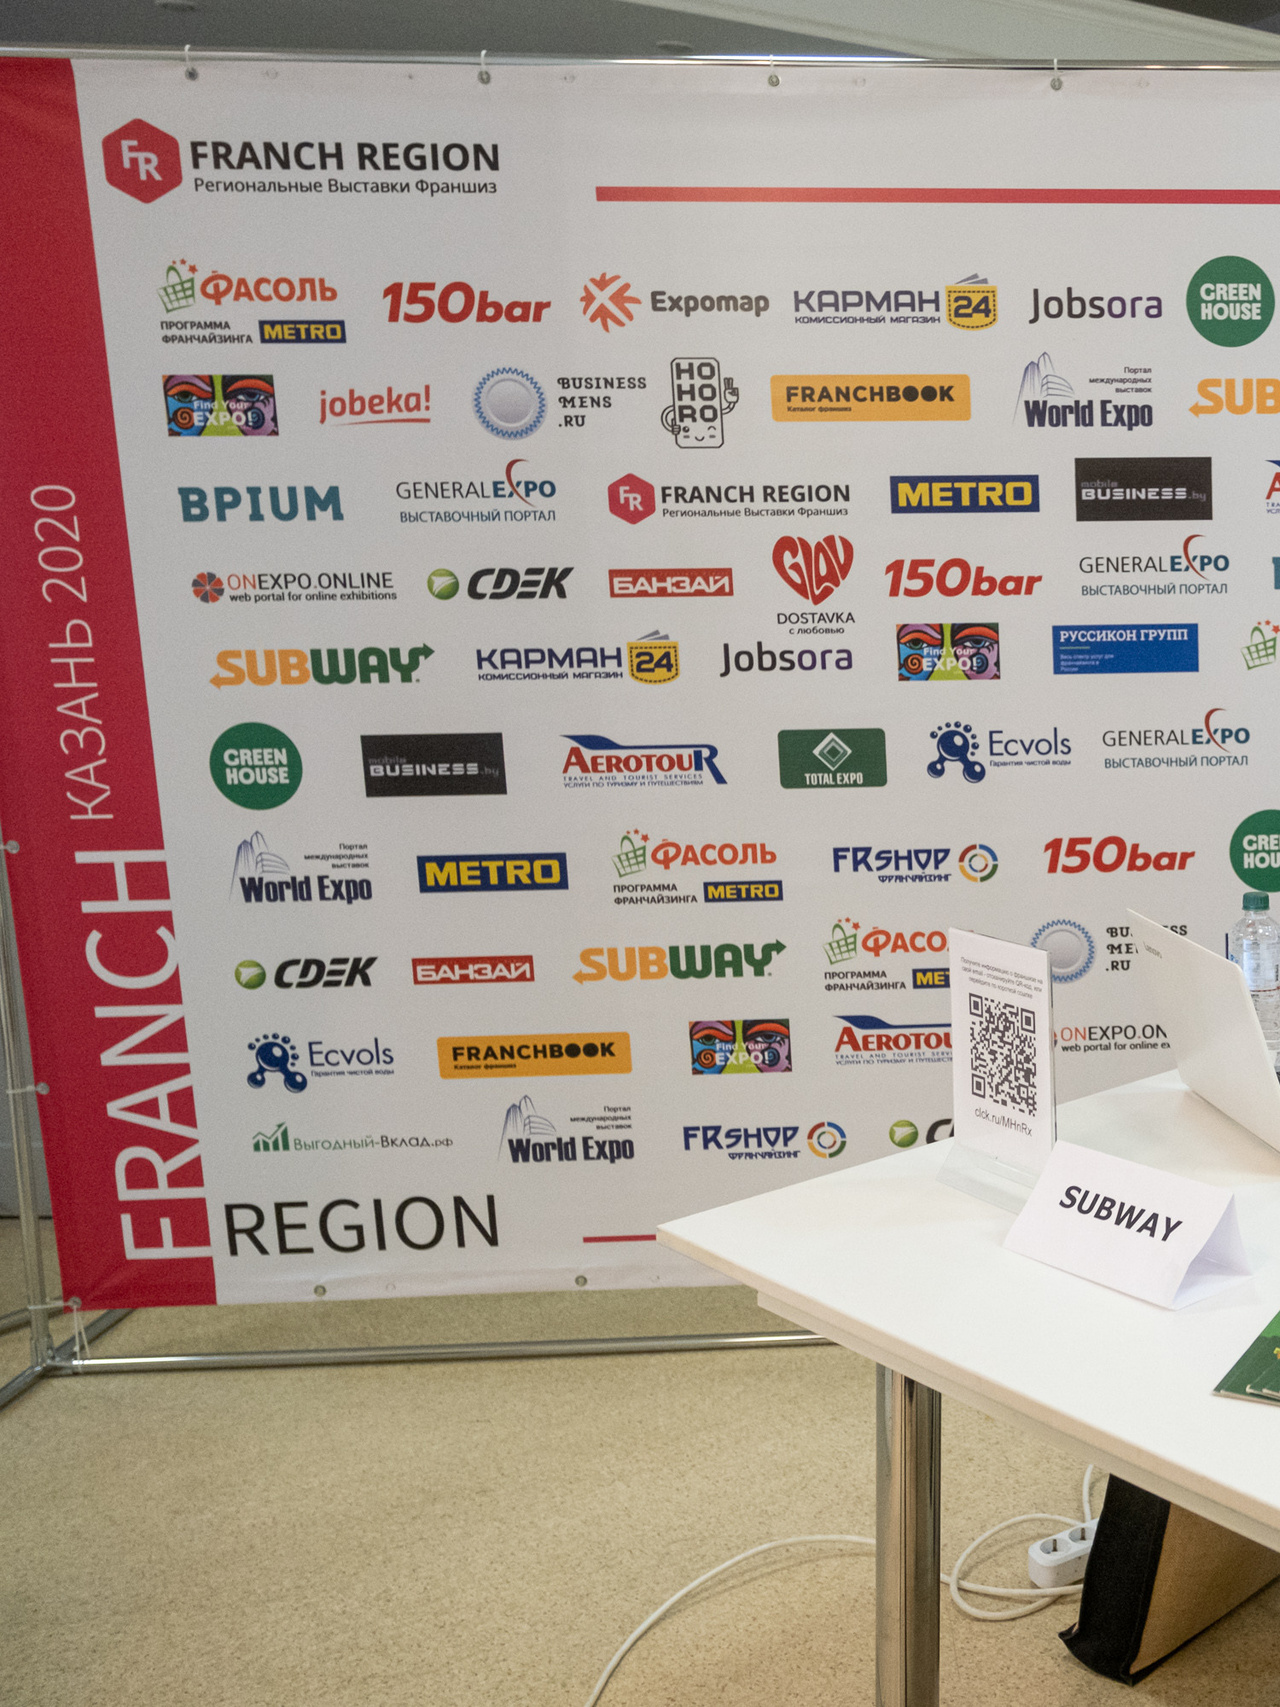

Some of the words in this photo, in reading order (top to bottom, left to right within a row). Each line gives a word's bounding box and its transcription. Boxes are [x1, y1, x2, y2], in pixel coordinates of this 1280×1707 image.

[190, 140, 344, 171] FRANCH
[357, 142, 500, 172] REGION
[194, 177, 323, 194] Региональные
[328, 178, 411, 193] Выставки
[415, 178, 497, 197] Франшиз
[200, 269, 338, 305] ФАСОЛЬ
[1200, 283, 1261, 301] GREEN
[382, 281, 551, 323] 150bar
[650, 290, 769, 317] Expomap
[794, 290, 940, 313] КАРМАН
[953, 295, 992, 318] 24
[1029, 287, 1163, 324] Jobsora
[795, 315, 885, 324] КОМИССИОННЫЙ
[890, 315, 940, 324] МАГАЗИН
[1201, 303, 1261, 321] HOUSE
[160, 320, 231, 331] ПРОГРАММА
[161, 332, 253, 344] ФРАНЧАЙЗИНГА
[263, 323, 342, 340] METRO
[675, 362, 716, 381] HO
[1124, 366, 1152, 375] Портал
[557, 376, 647, 390] BUSINESS
[676, 383, 718, 401] HO
[558, 396, 612, 408] MENS
[786, 385, 955, 403] FRANCHBOOK
[320, 385, 431, 424] jobeka!
[678, 404, 718, 423] RO
[193, 411, 253, 426] EXPO!
[558, 415, 586, 427] .RU
[1024, 400, 1094, 428] World
[1100, 400, 1153, 431] Expo
[177, 485, 344, 522] BPIUM
[661, 485, 755, 504] FRANCH
[762, 485, 850, 503] REGION
[897, 481, 1033, 508] METRO
[400, 509, 500, 523] ВЫСТАВОЧНЫЙ
[504, 510, 556, 523] ПОРТАЛ
[662, 508, 741, 519] Региональные
[745, 507, 795, 517] Выставки
[797, 507, 848, 518] Франшиз
[30, 484, 88, 603] 2020
[227, 572, 394, 590] ONEXPO.ONLINE
[467, 567, 574, 600] CDEK
[612, 576, 730, 595] БАНЗАЙ
[884, 558, 1043, 598] 150bar
[229, 592, 251, 602] web
[254, 591, 286, 603] portal
[288, 591, 302, 601] for
[305, 591, 338, 601] online
[340, 590, 397, 601] exhibitions
[1081, 582, 1176, 596] ВЫСТАВОЧНЫЙ
[1179, 583, 1228, 596] ПОРТАЛ
[777, 612, 856, 625] DOSTAVKA
[796, 625, 845, 636] любовью
[1059, 630, 1137, 643] РУССИКОН
[1140, 629, 1188, 641] ГРУПП
[209, 642, 436, 690] SUBWAY
[476, 647, 622, 671] КАРМАН
[634, 651, 674, 674] 24
[720, 641, 853, 677] Jobsora
[922, 656, 978, 671] EXPO!
[478, 671, 569, 681] КОМИССИОННЫЙ
[573, 671, 623, 679] МАГАЗИН
[49, 618, 114, 820] КАЗАНЬ
[988, 728, 1072, 757] Ecvols
[223, 747, 287, 766] GREEN
[1104, 755, 1198, 769] ВЫСТАВОЧНЫЙ
[1201, 755, 1248, 767] ПОРТАЛ
[226, 766, 290, 785] HOUSE
[805, 773, 834, 785] TOTAL
[836, 773, 863, 785] EXPO
[651, 838, 777, 870] ФАСОЛЬ
[1043, 836, 1195, 874] 150bar
[425, 858, 562, 886] METRO
[239, 876, 313, 903] World
[318, 875, 373, 904] Expo
[613, 883, 678, 894] ПРОГРАММА
[614, 894, 698, 905] ФРАНЧАЙЗИНГА
[708, 883, 780, 900] METRO
[572, 937, 787, 985] SUBWAY
[274, 956, 378, 990] CDEK
[416, 961, 531, 981] БАНЗАЙ
[824, 970, 887, 980] ПРОГРАММА
[824, 980, 906, 991] ФРАНЧАЙЗИНГА
[75, 848, 213, 1261] FRANCH
[308, 1038, 394, 1068] Ecvols
[452, 1042, 616, 1062] FRANCHBOOK
[1061, 1043, 1082, 1052] web
[1083, 1042, 1112, 1053] portal
[1129, 1041, 1158, 1050] online
[714, 1051, 771, 1066] EXPO!
[507, 1137, 577, 1164] World
[582, 1136, 635, 1164] Expo
[1058, 1185, 1183, 1242] SUBWAY
[223, 1194, 500, 1257] REGION
